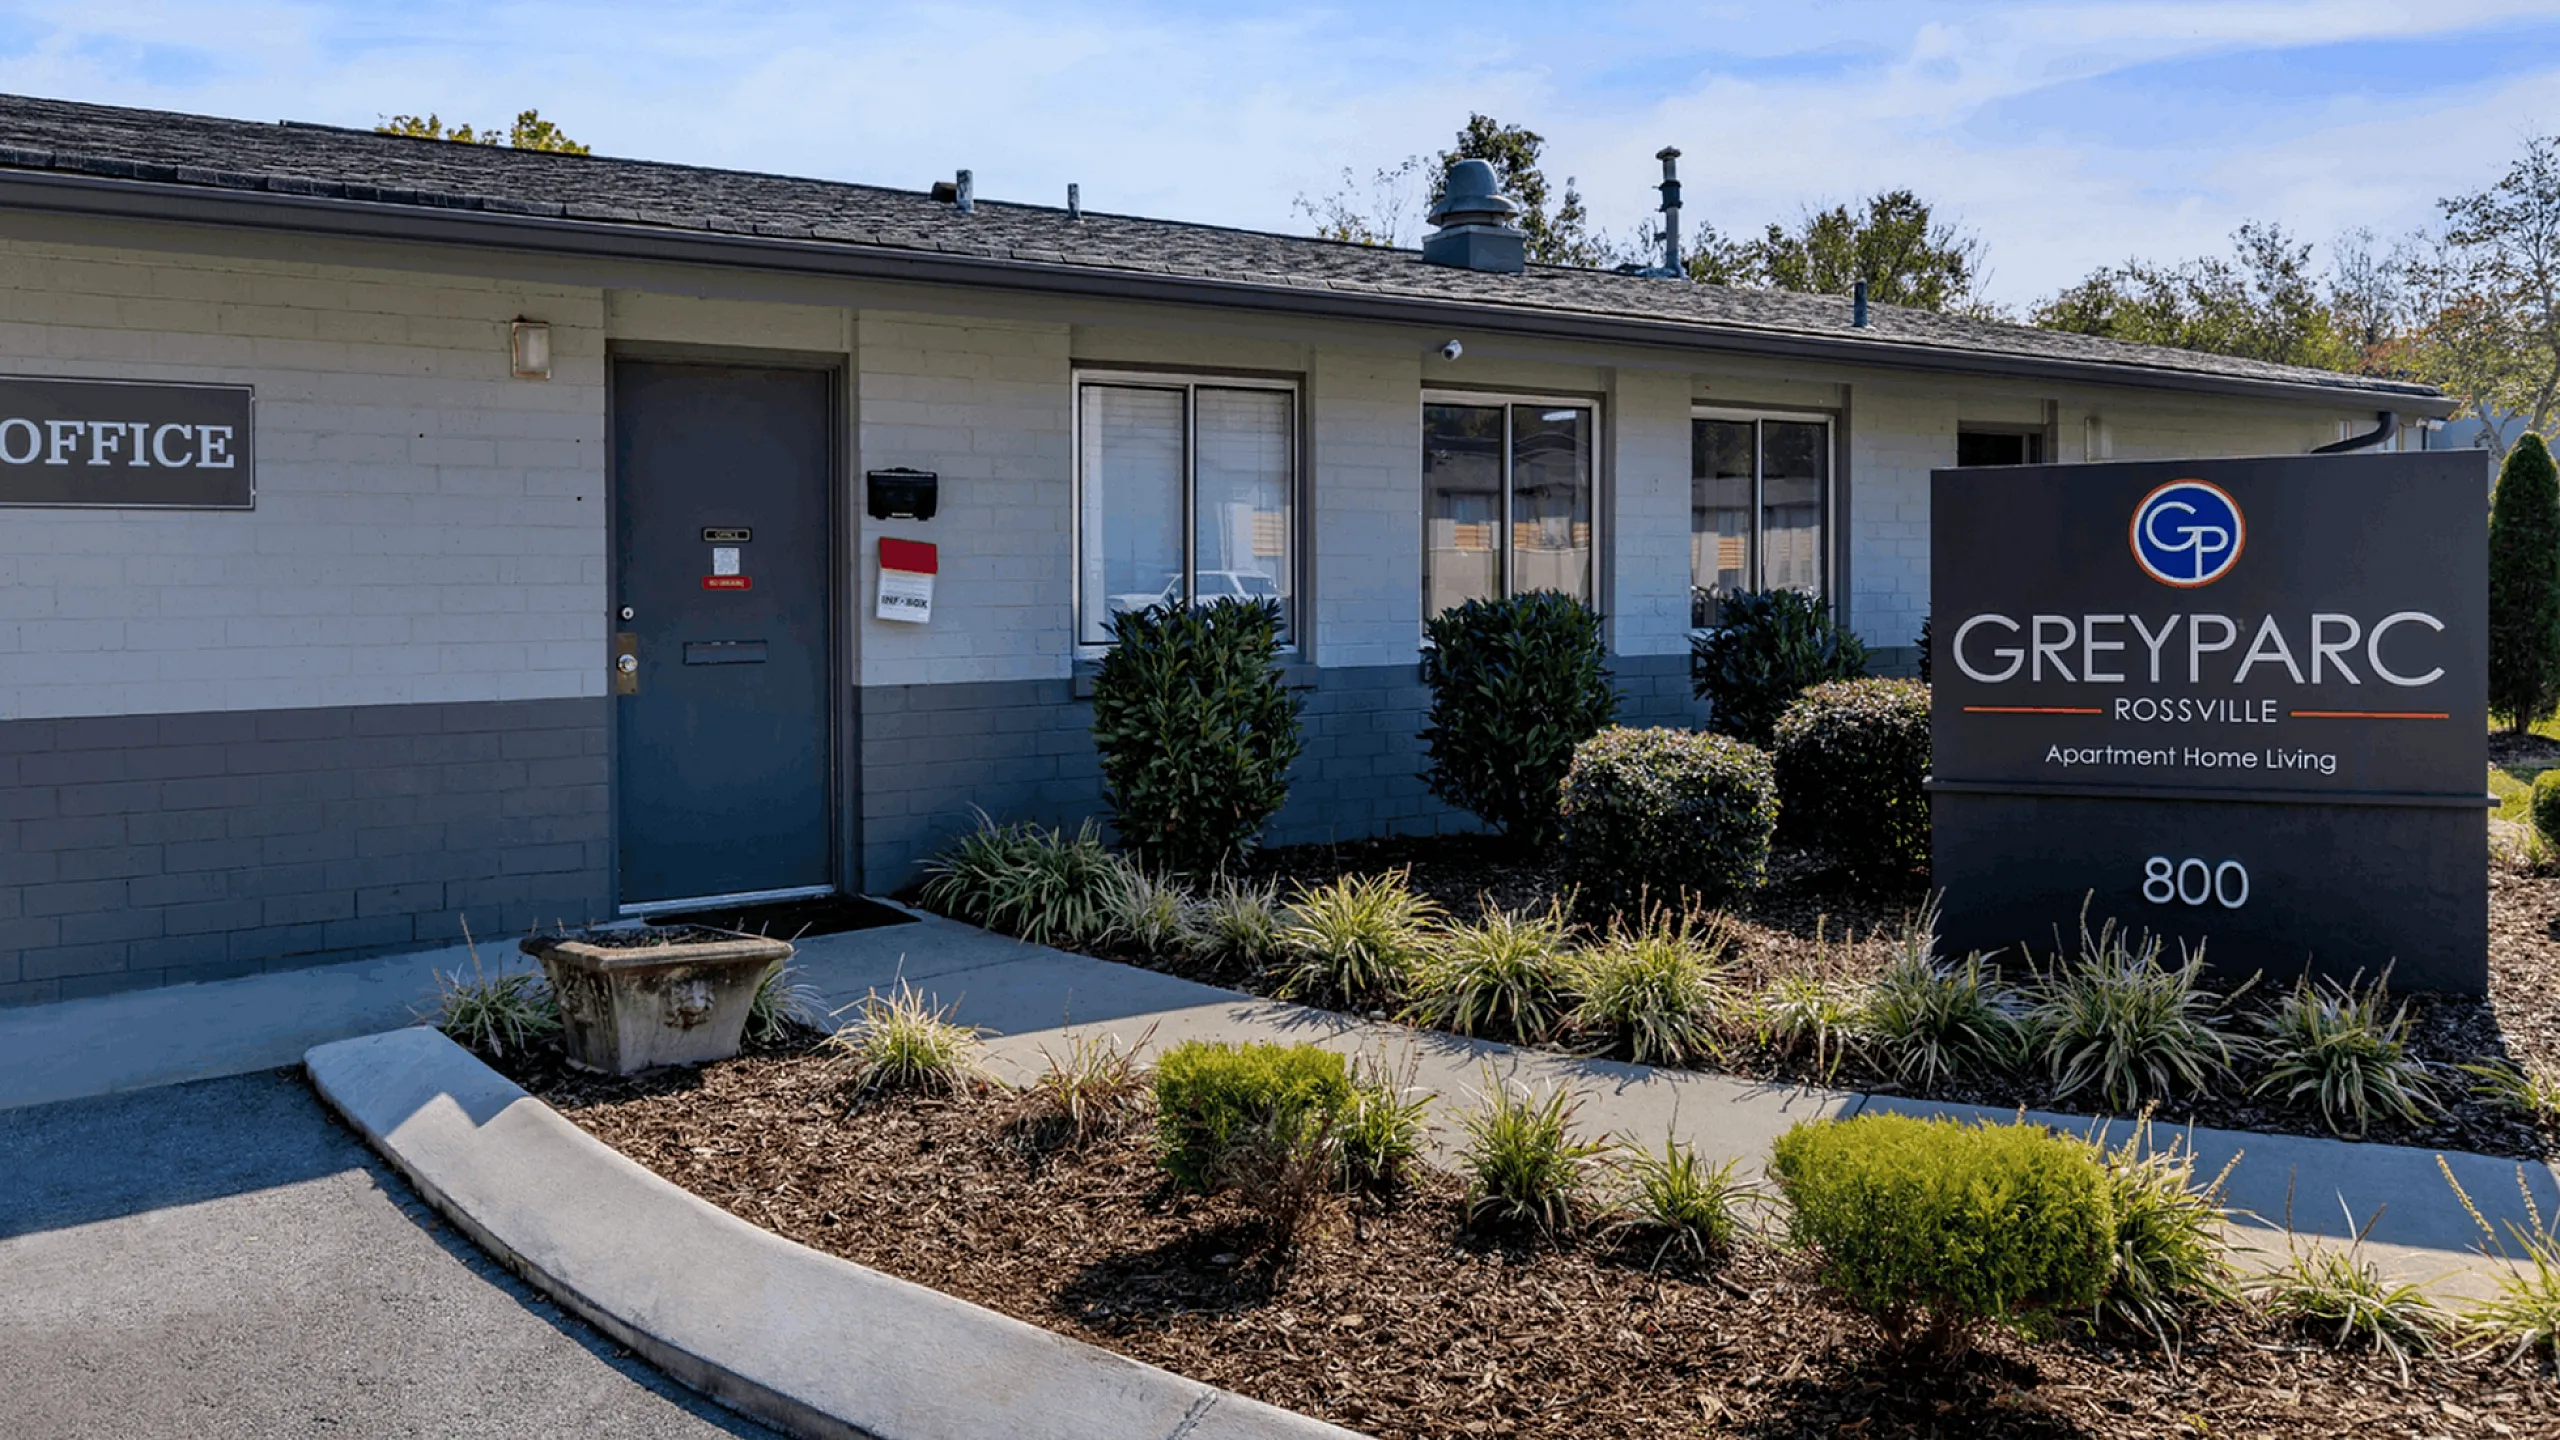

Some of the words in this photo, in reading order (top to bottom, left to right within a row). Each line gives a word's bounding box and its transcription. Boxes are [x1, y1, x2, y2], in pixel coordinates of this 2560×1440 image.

[0, 418, 235, 468] OFFICE
[2146, 501, 2229, 580] GP
[1953, 611, 2446, 686] GREYPARC
[2114, 697, 2278, 723] ROSSVILLE
[2045, 744, 2176, 767] Apartment
[2184, 747, 2258, 768] Home
[2266, 748, 2337, 775] Living
[2142, 857, 2250, 909] 800
